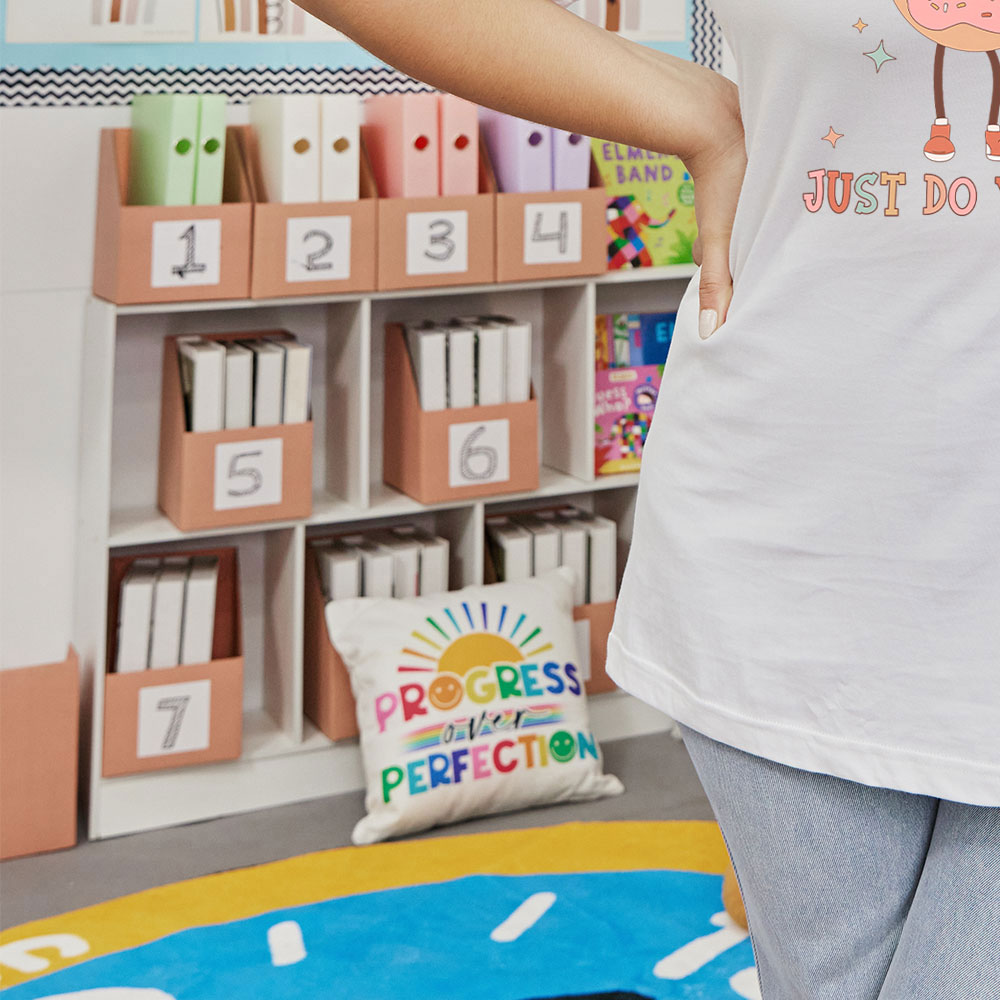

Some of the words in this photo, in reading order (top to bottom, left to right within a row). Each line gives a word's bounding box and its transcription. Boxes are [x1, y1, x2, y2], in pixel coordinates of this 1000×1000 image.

[616, 164, 674, 185] BAND
[802, 169, 907, 217] JUST
[922, 173, 978, 217] DO
[171, 224, 207, 279] 1
[301, 229, 334, 271] 2
[424, 219, 456, 263] 3
[531, 211, 568, 254] 4
[226, 449, 264, 497] 5
[459, 425, 500, 481] 6
[375, 661, 582, 733] PROGRESS
[156, 694, 190, 751] 7
[443, 708, 529, 744] over
[381, 730, 599, 804] PERFECTION
